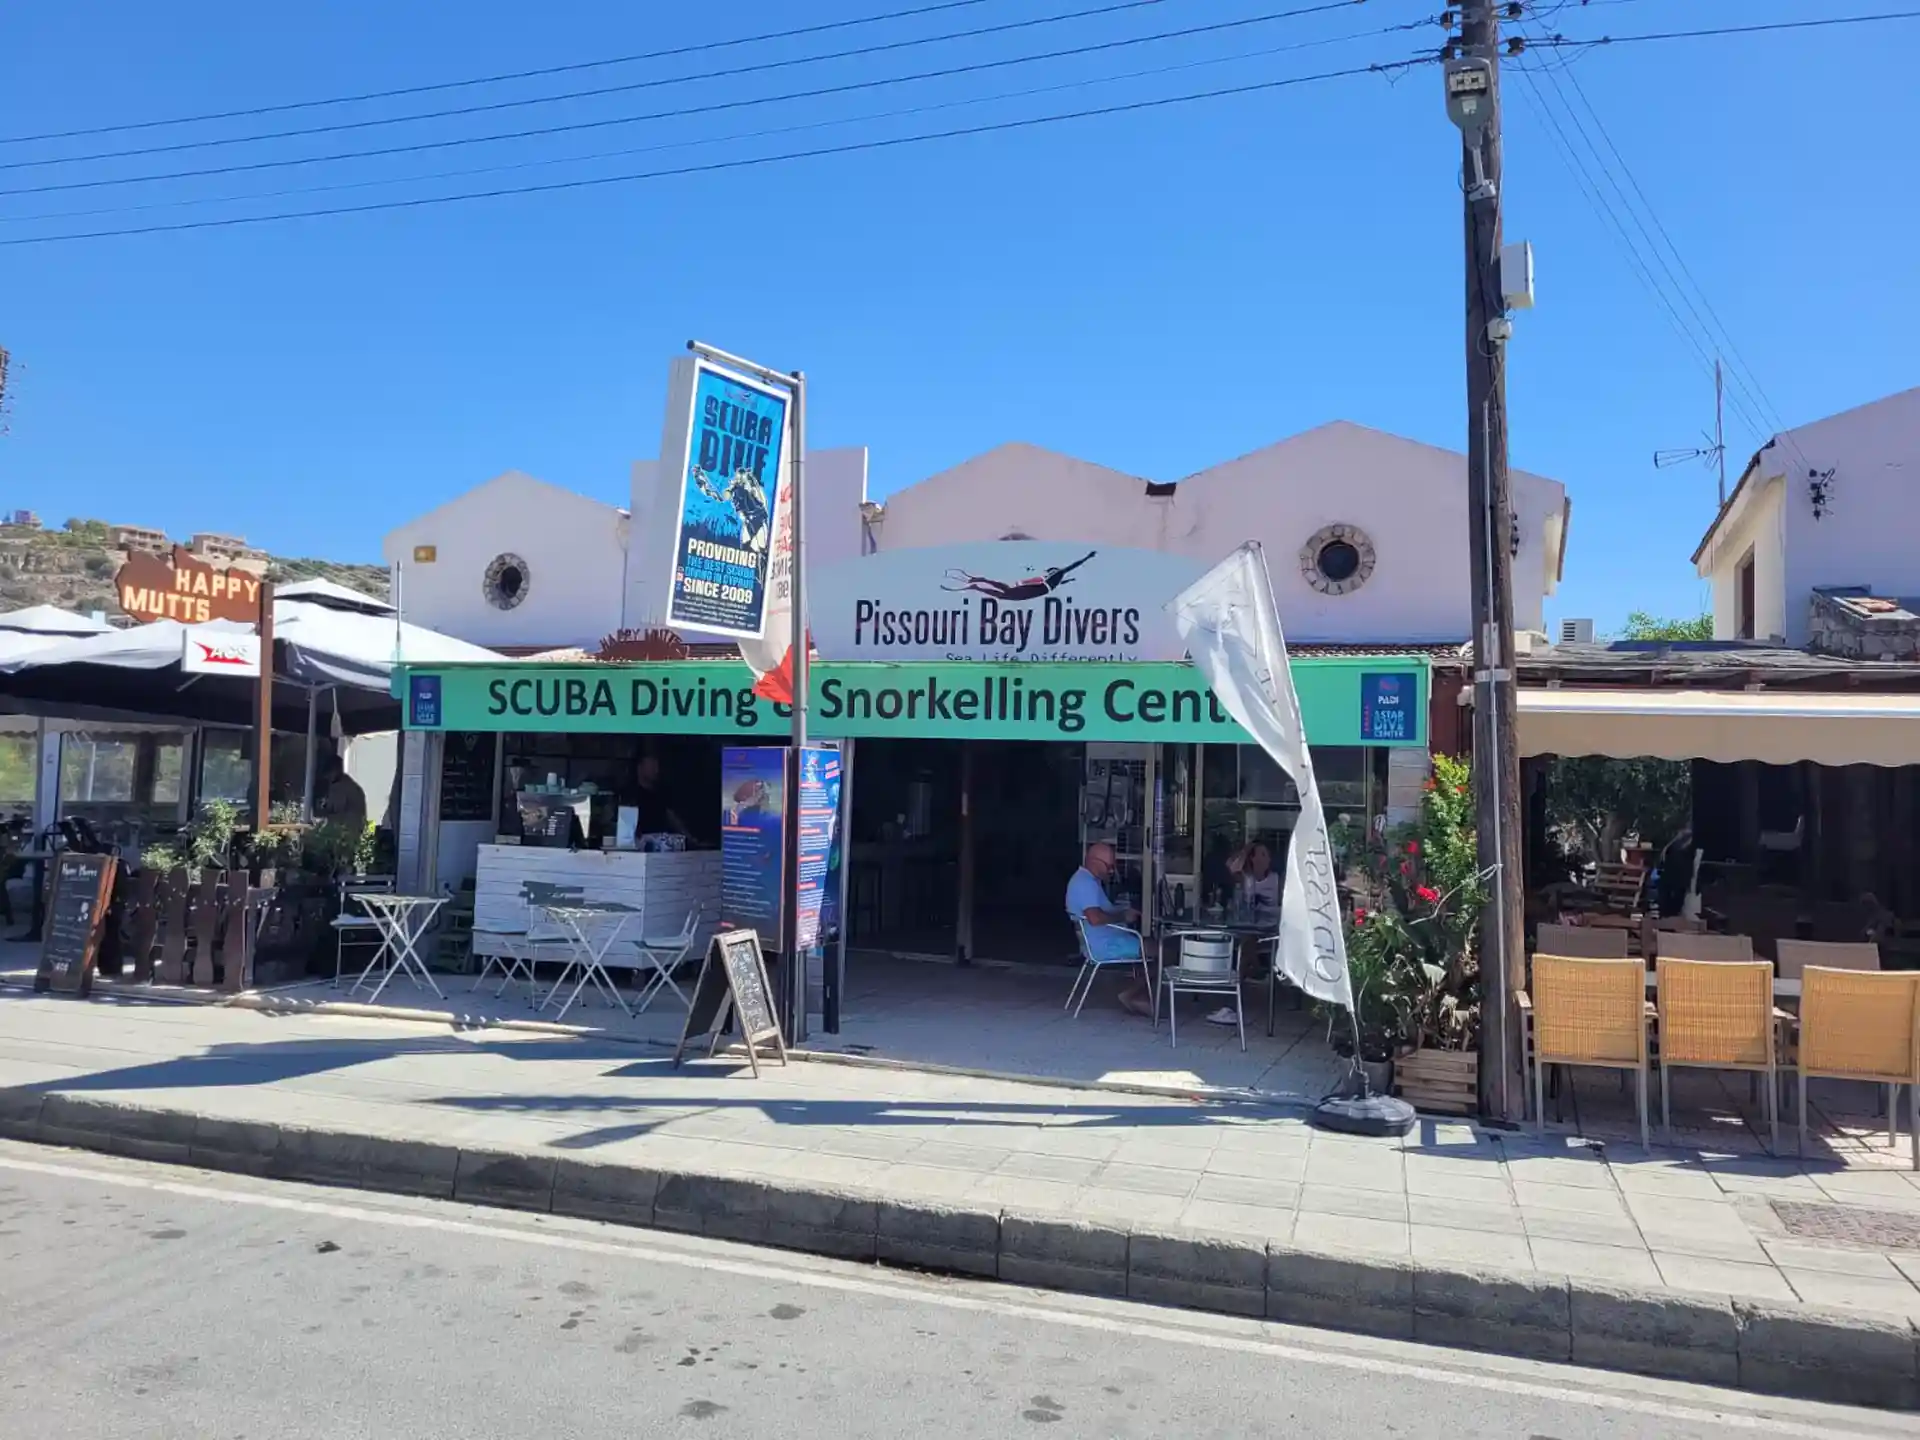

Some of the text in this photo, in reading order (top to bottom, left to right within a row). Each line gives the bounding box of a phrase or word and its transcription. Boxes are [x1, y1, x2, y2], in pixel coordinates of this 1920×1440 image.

[704, 395, 773, 446] SCUBA
[699, 428, 769, 485] DIVE
[687, 537, 757, 568] PROVIDING
[123, 585, 210, 621] MUTTS
[176, 568, 259, 603] HAPPY
[683, 577, 720, 598] SINCE
[855, 596, 1139, 653] Pissouri Bay Divers
[946, 652, 972, 661] Sea
[1031, 652, 1137, 662] Differently
[488, 679, 617, 716] SCUBA
[631, 677, 758, 727] Diving
[820, 676, 1086, 733] Snorkelling
[1103, 679, 1236, 724] Cent
